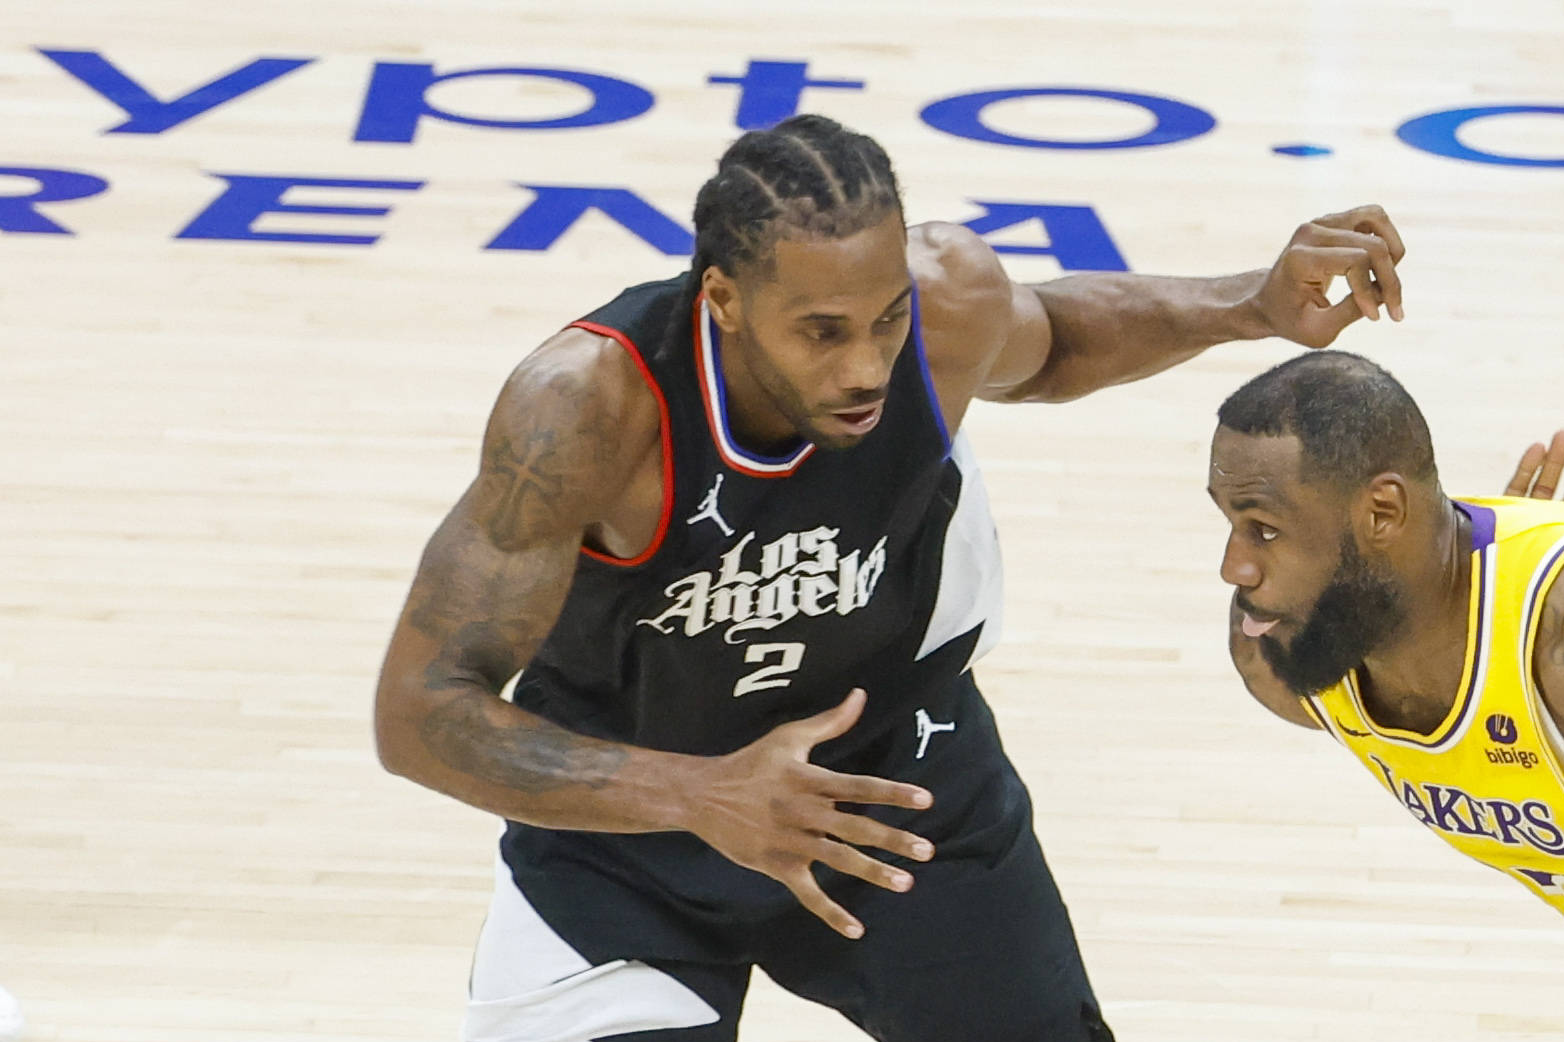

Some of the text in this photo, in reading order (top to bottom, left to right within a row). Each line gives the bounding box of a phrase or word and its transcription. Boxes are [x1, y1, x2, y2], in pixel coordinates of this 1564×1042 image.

[711, 526, 840, 590] Los
[733, 643, 806, 697] 2
[1485, 748, 1539, 769] bibigo
